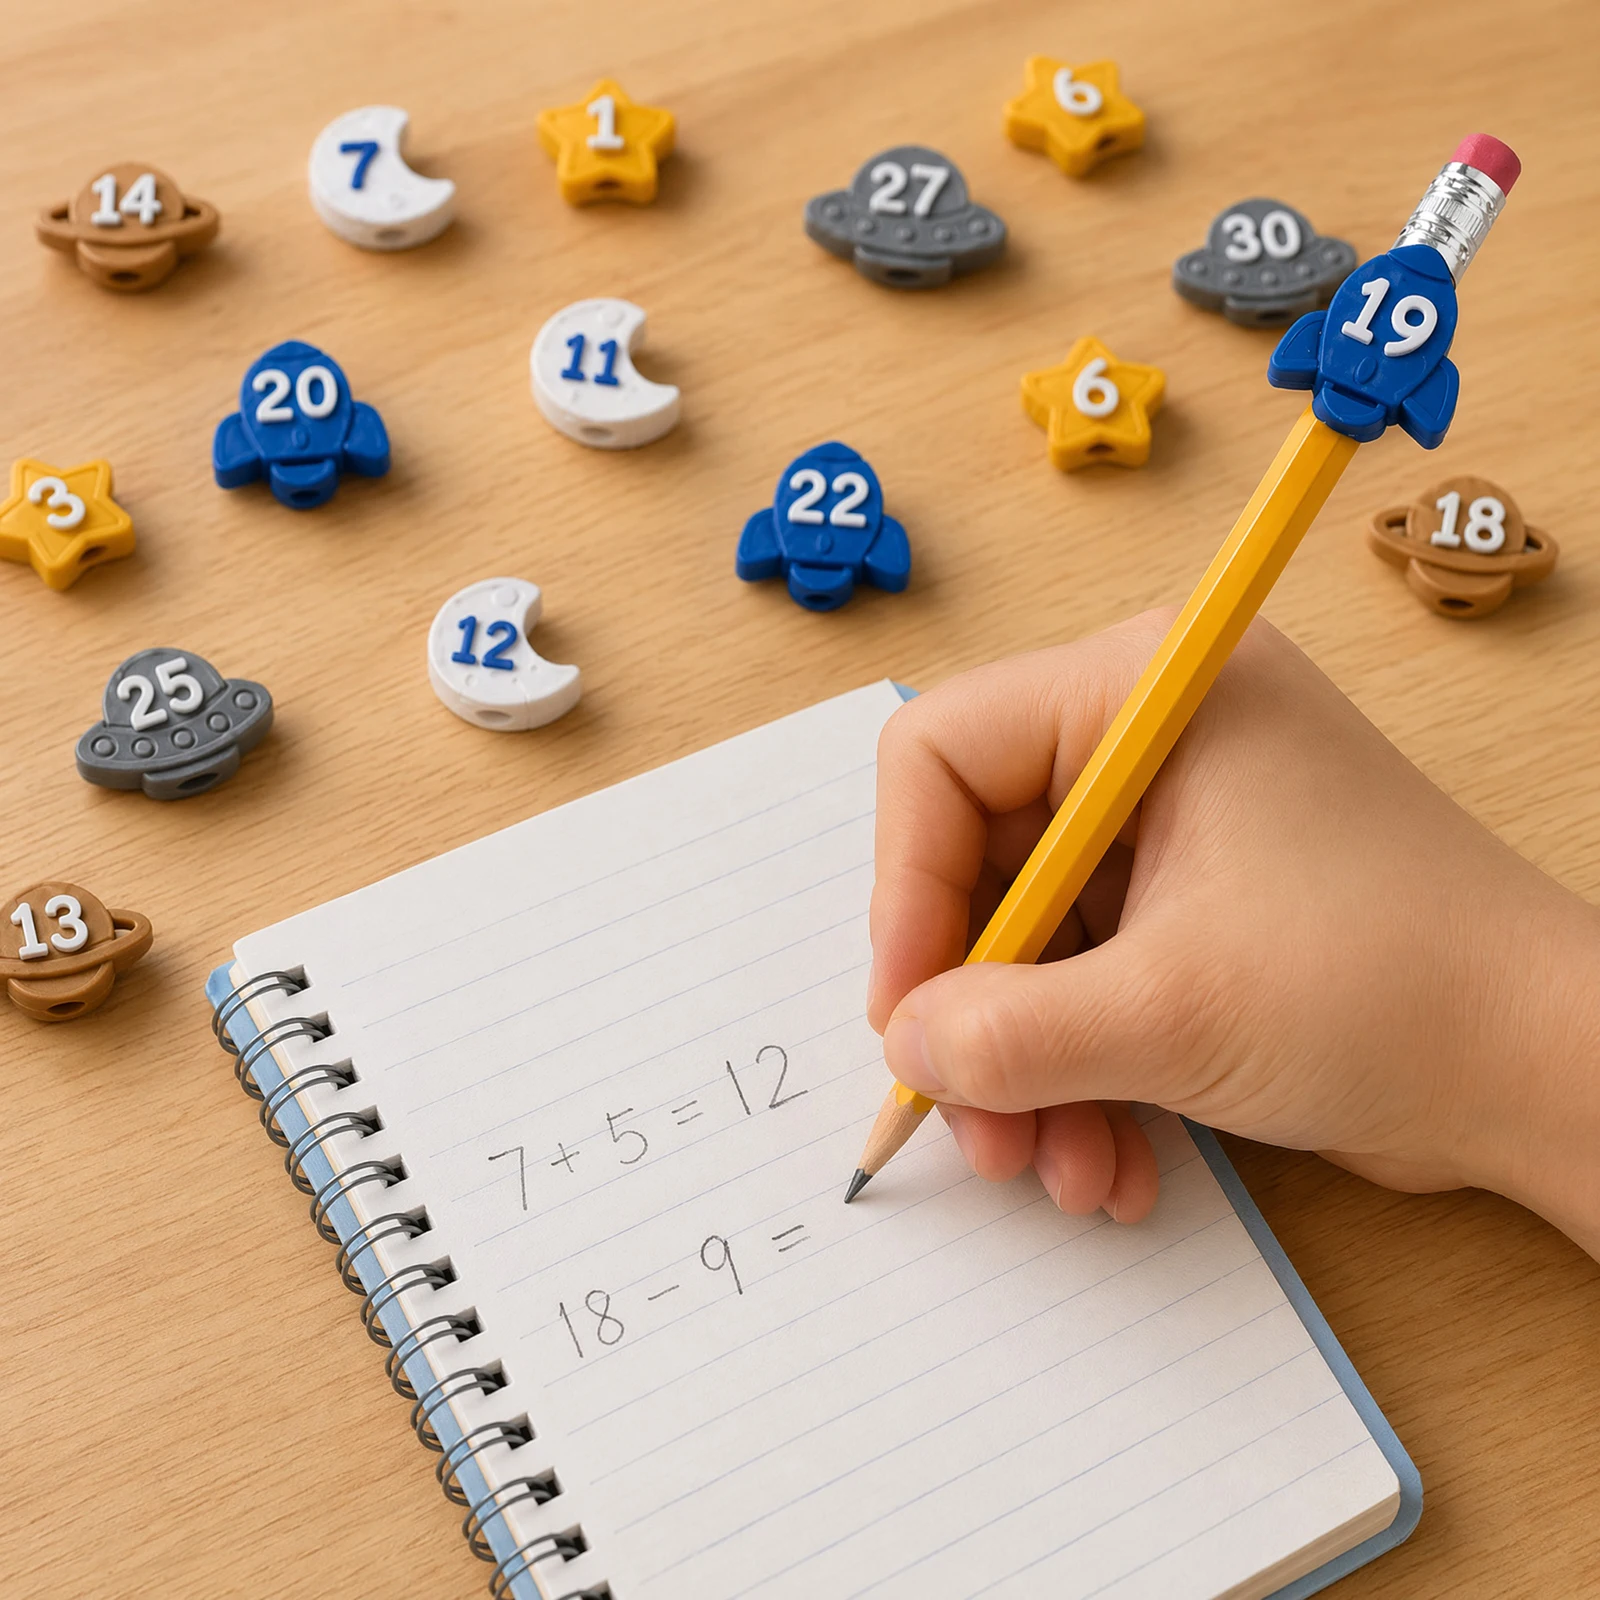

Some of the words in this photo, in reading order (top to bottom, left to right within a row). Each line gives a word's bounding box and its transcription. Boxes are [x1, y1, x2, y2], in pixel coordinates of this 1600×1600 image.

[1053, 67, 1103, 117] 6
[585, 94, 625, 150] 1
[339, 140, 380, 190] 7
[868, 161, 951, 217] 27
[90, 173, 163, 227] 14
[1221, 210, 1303, 265] 30
[1340, 277, 1439, 358] 19
[560, 333, 621, 388] 11
[1072, 356, 1120, 418] 6
[251, 365, 339, 423] 20
[27, 476, 87, 530] 3
[786, 468, 871, 529] 22
[1429, 490, 1508, 555] 18
[451, 614, 519, 671] 12
[116, 656, 205, 732] 25
[10, 894, 90, 961] 13
[488, 1146, 528, 1210] 7
[606, 1108, 648, 1164] 5
[726, 1045, 808, 1115] 12
[559, 1289, 625, 1358] 18
[700, 1235, 743, 1295] 9
